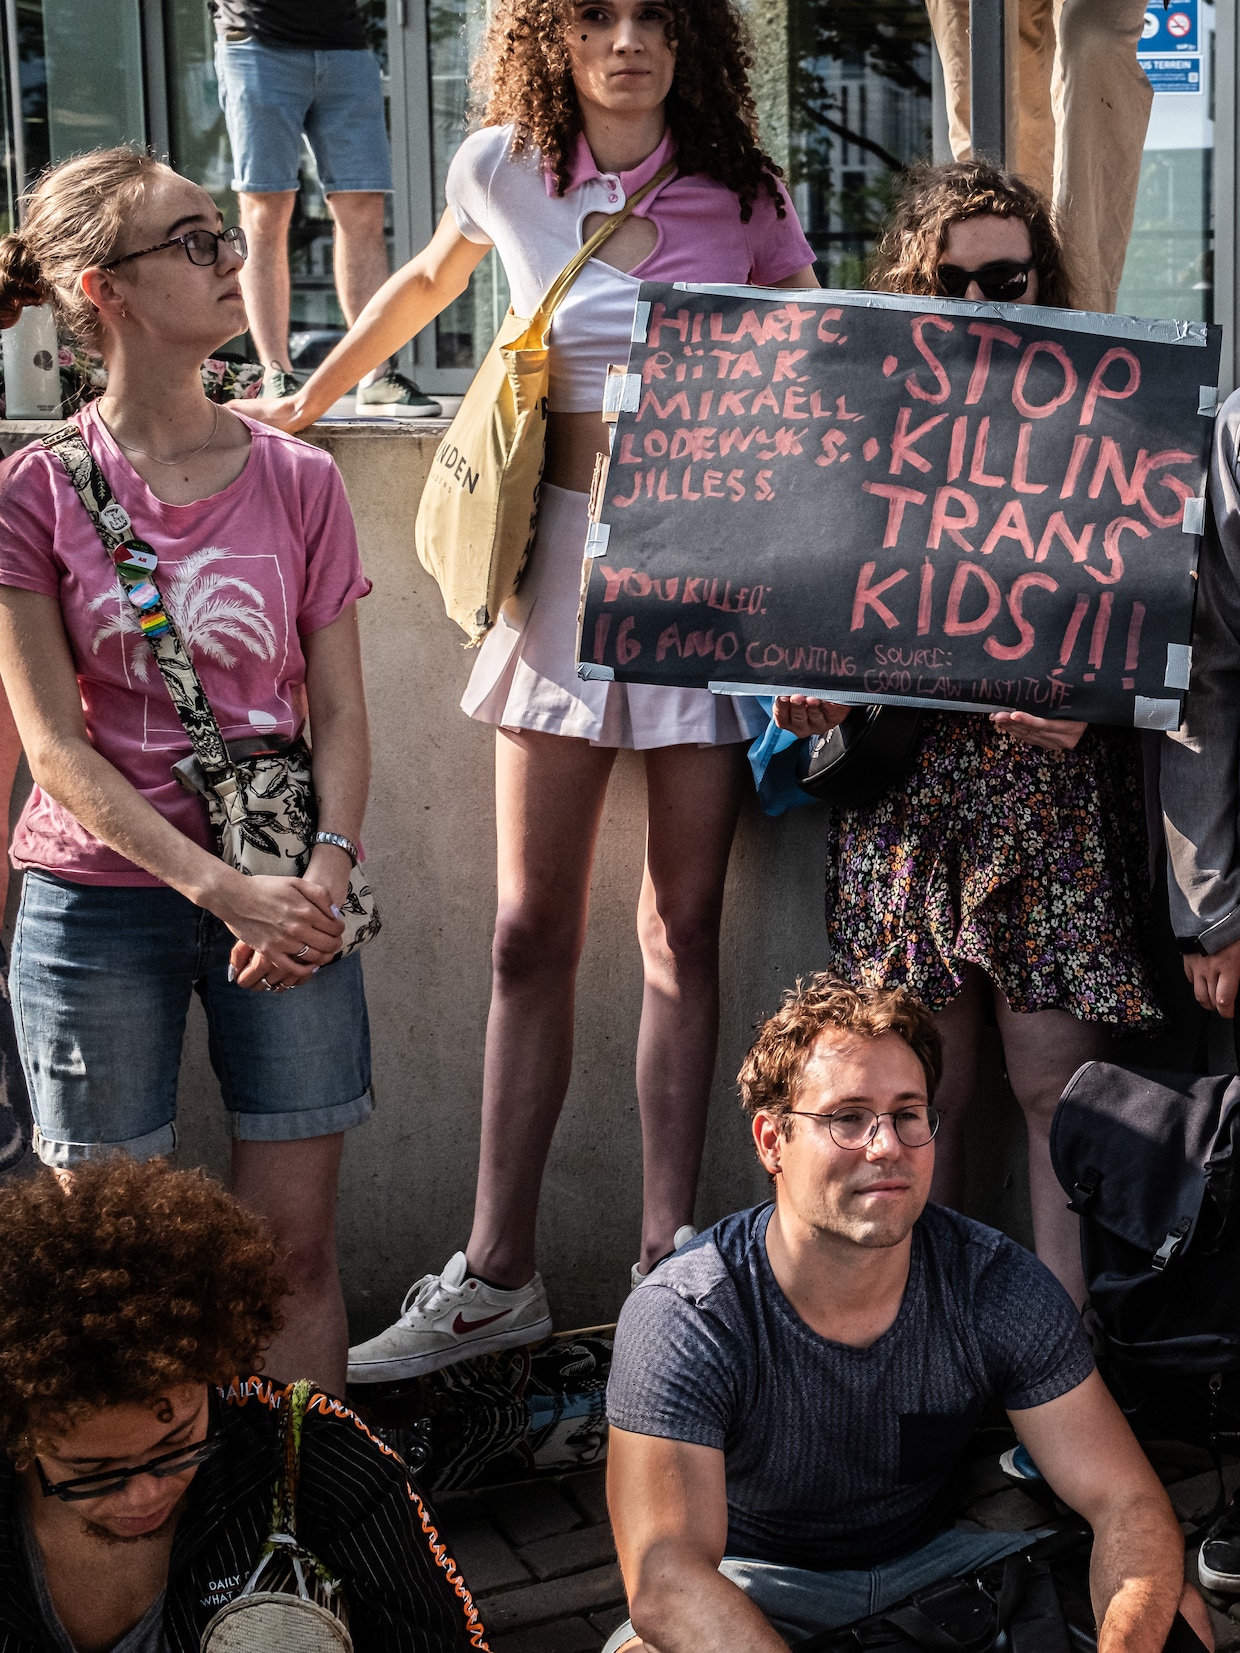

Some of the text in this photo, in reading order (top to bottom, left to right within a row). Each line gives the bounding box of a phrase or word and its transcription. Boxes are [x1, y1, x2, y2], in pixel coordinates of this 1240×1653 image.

[905, 314, 1142, 427] STOP
[611, 465, 746, 508] JILLES
[887, 406, 1198, 529] KILLING
[861, 480, 1152, 585] TRANS
[592, 612, 857, 678] 16 AND COUNTING
[862, 670, 1075, 711] GOOD LAW INSTITUTE
[199, 1590, 234, 1608] WHAT
[208, 1574, 241, 1591] DAILY
